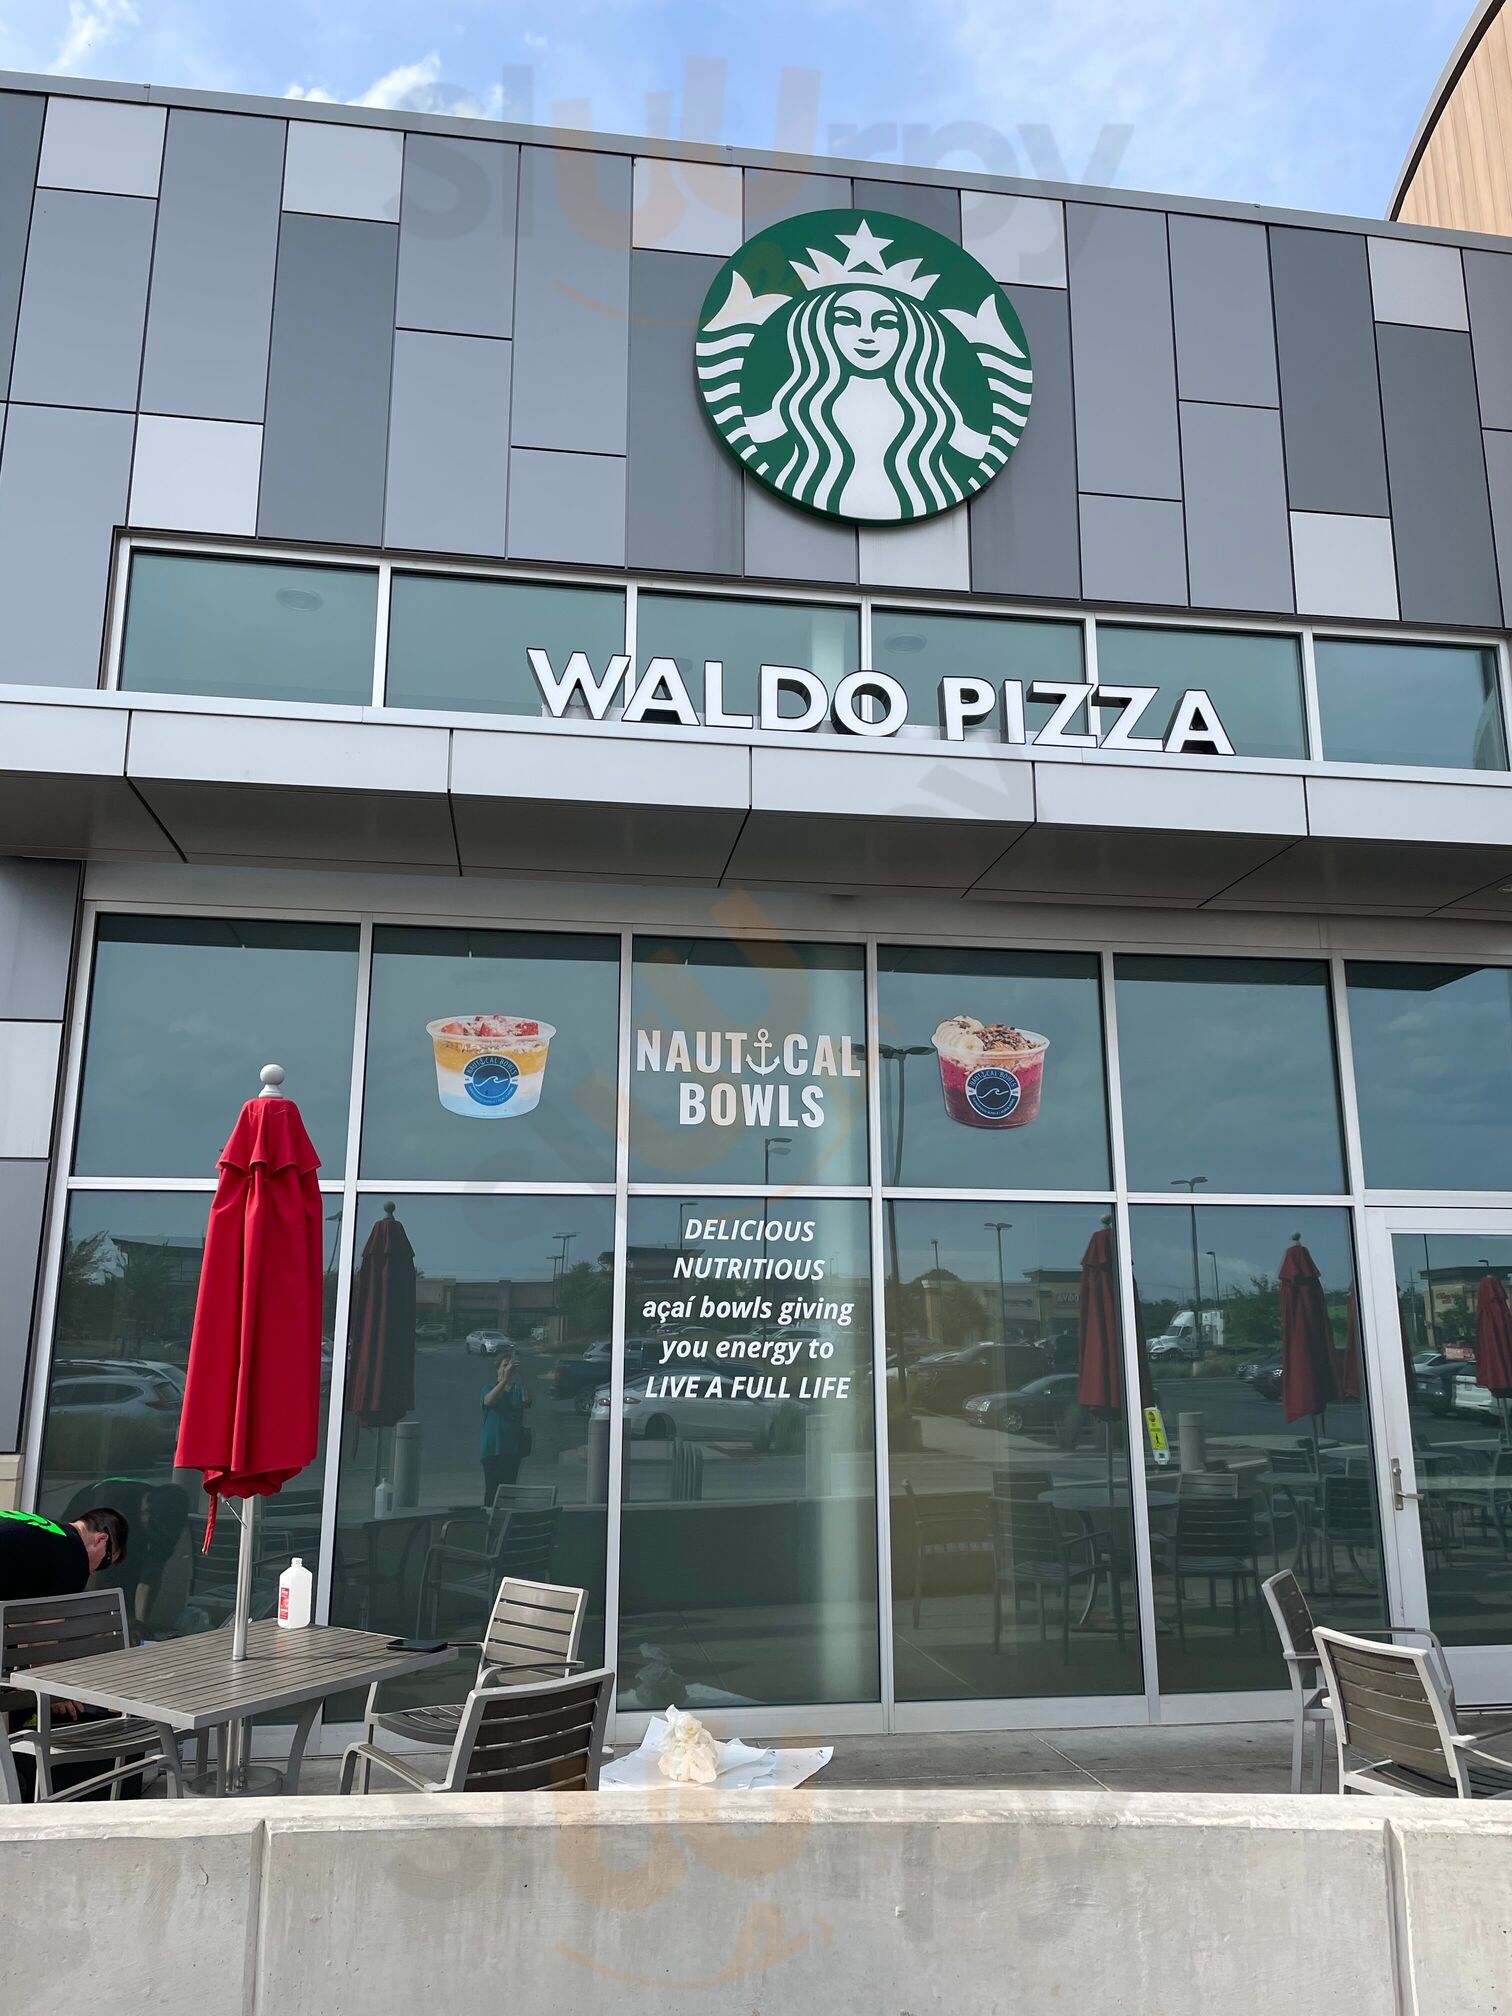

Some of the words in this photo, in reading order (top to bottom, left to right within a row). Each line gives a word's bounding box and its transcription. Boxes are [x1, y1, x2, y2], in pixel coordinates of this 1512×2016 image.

[526, 646, 909, 738] WALDO
[938, 675, 1237, 757] PIZZA
[679, 1082, 825, 1128] BOWLS
[685, 1218, 815, 1242] DELICIOUS
[673, 1256, 825, 1281] NUTRITIOUS
[642, 1295, 696, 1323] açaí
[700, 1295, 772, 1319] bowls
[777, 1297, 854, 1326] giving
[658, 1340, 708, 1364] you
[715, 1340, 802, 1366] energy
[808, 1339, 834, 1359] to
[645, 1376, 699, 1399] LIVE
[705, 1376, 723, 1399] A
[730, 1376, 791, 1399] FULL
[799, 1376, 851, 1399] LIFE
